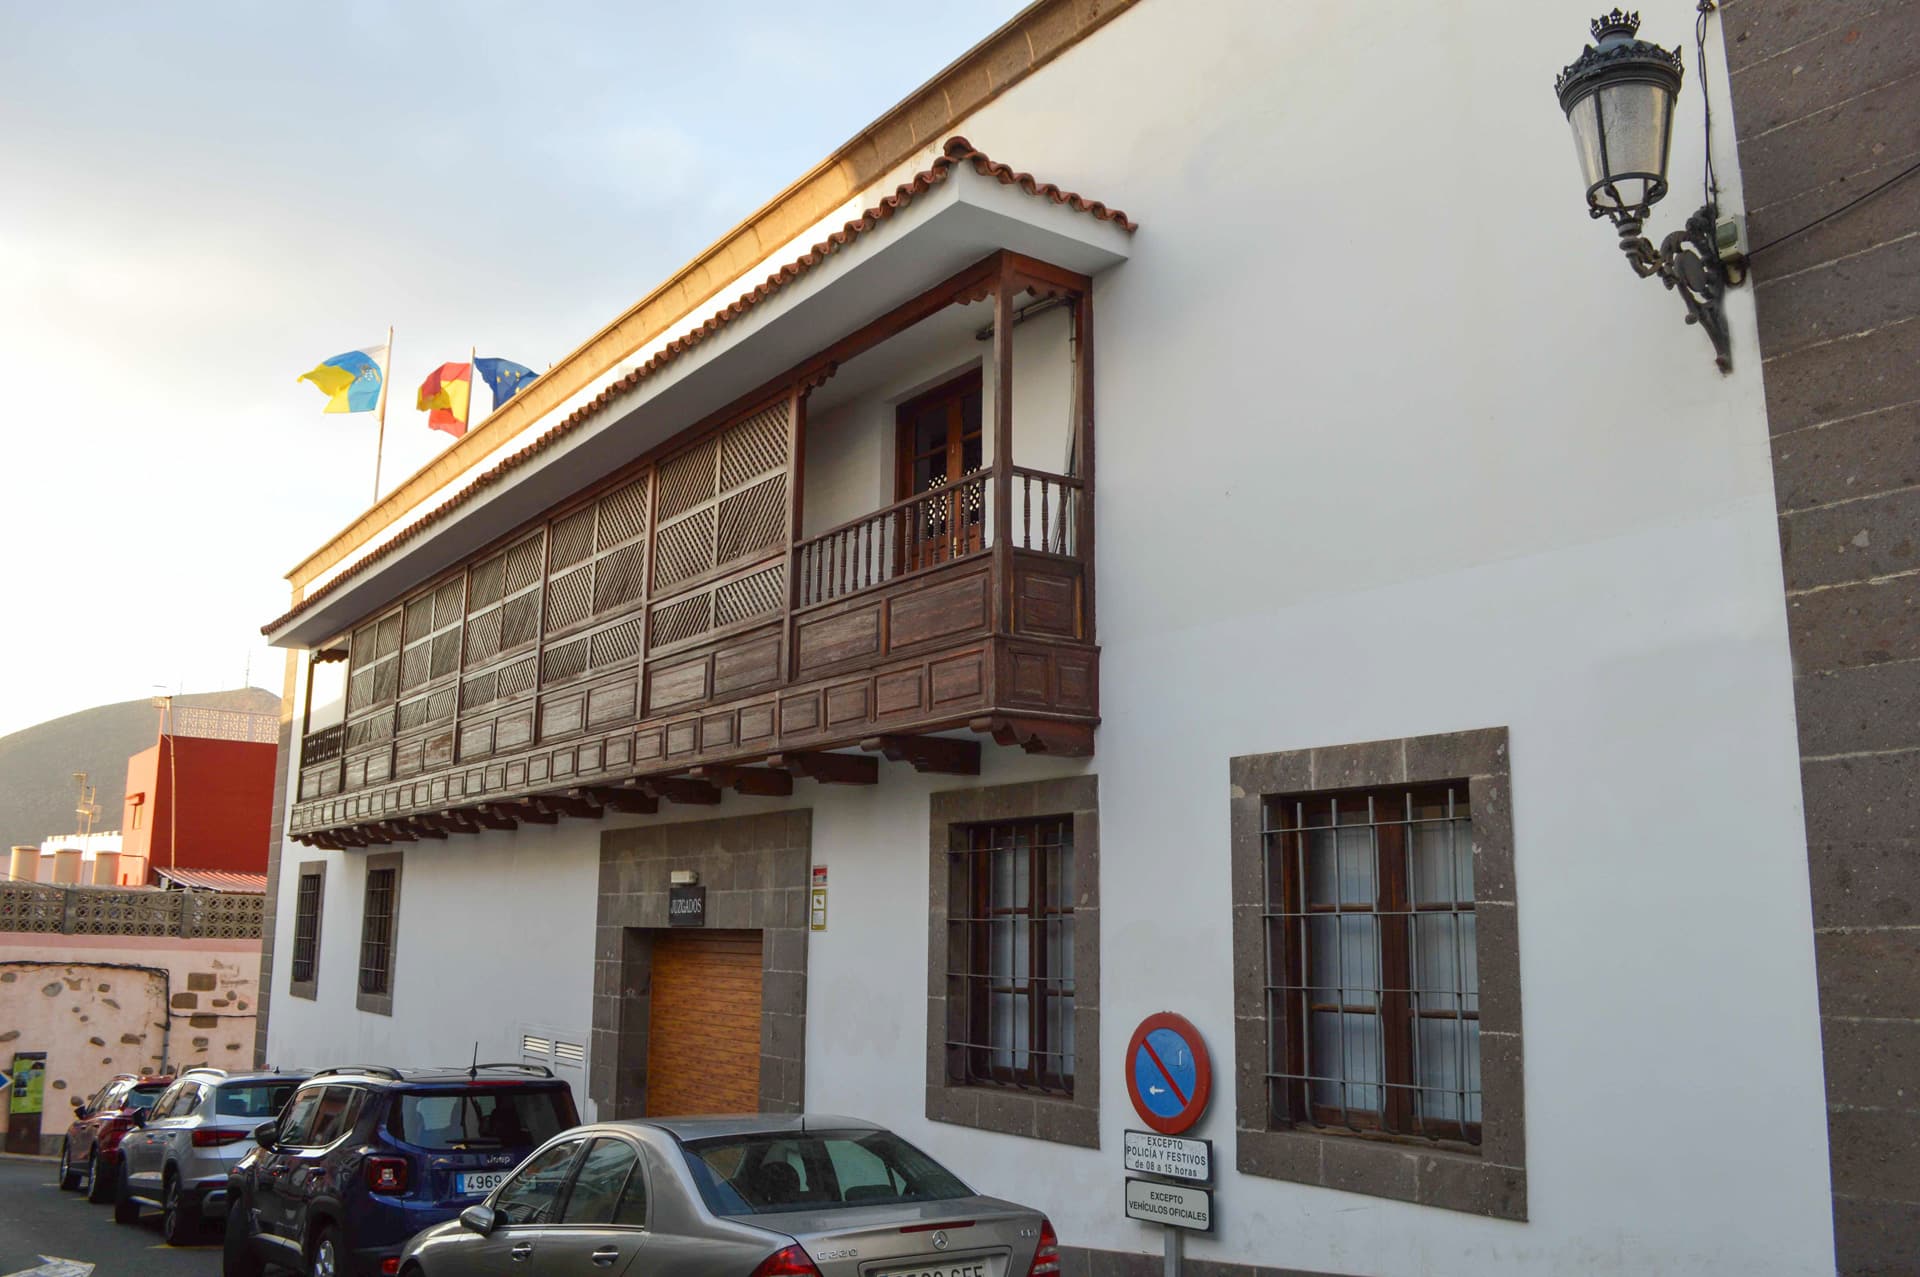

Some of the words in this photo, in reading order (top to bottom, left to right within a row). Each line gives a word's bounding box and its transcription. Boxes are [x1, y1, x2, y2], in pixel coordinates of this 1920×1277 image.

[671, 898, 702, 914] JUZGADOS
[1147, 1136, 1183, 1150] EXCEPTO
[1127, 1146, 1157, 1159] POLICÍA
[1159, 1150, 1164, 1160] Y
[1166, 1151, 1206, 1166] FESTIVOS
[1134, 1160, 1144, 1169] de
[1145, 1161, 1155, 1170] 08
[1164, 1163, 1172, 1173] 15
[1174, 1165, 1197, 1177] horas
[467, 1175, 502, 1190] 4969
[1150, 1191, 1184, 1205] EXCEPTO
[1128, 1200, 1168, 1215] VEHÍCULOS
[1168, 1207, 1207, 1222] OFICIALES
[817, 1251, 825, 1260] C
[829, 1248, 858, 1259] 220
